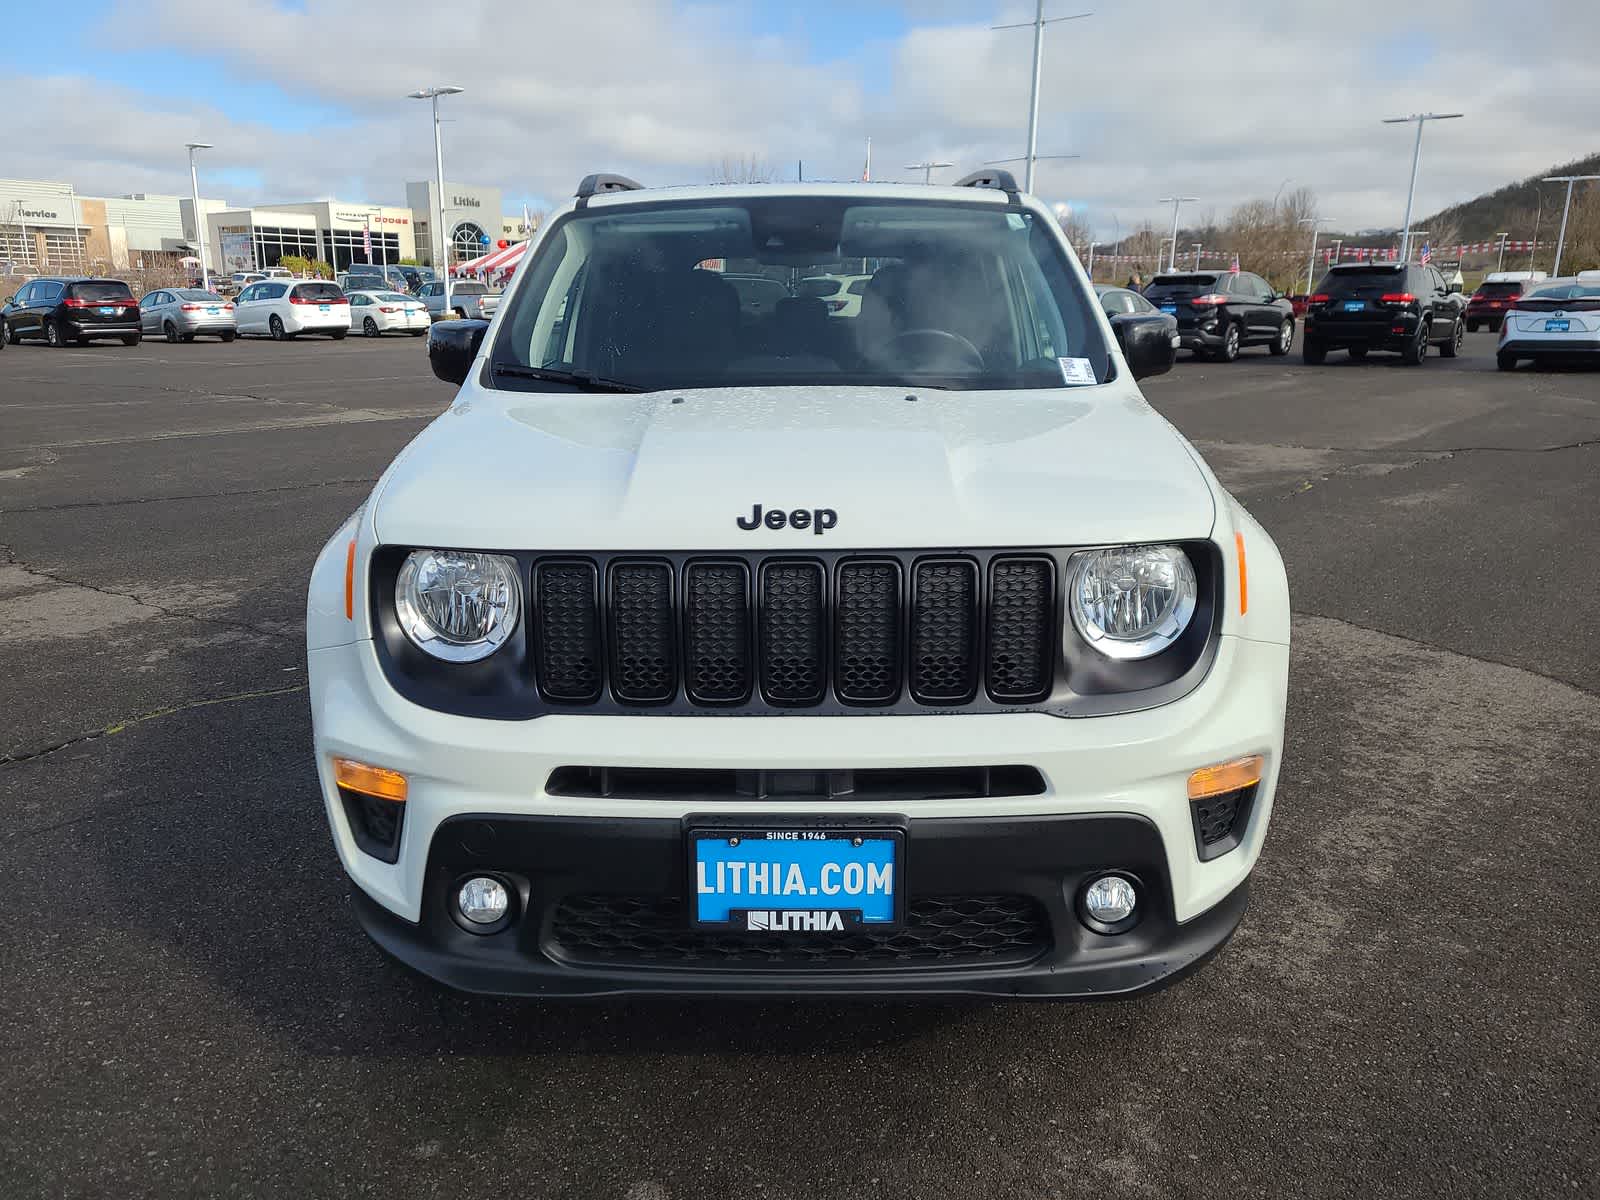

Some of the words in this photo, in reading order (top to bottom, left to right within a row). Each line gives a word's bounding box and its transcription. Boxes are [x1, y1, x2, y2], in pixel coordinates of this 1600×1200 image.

[454, 195, 480, 207] Lithia
[736, 503, 838, 535] Jeep
[766, 832, 799, 840] SINCE
[801, 832, 826, 840] 1946
[697, 861, 893, 895] LITHIA.COM
[769, 911, 845, 931] LITHIA
